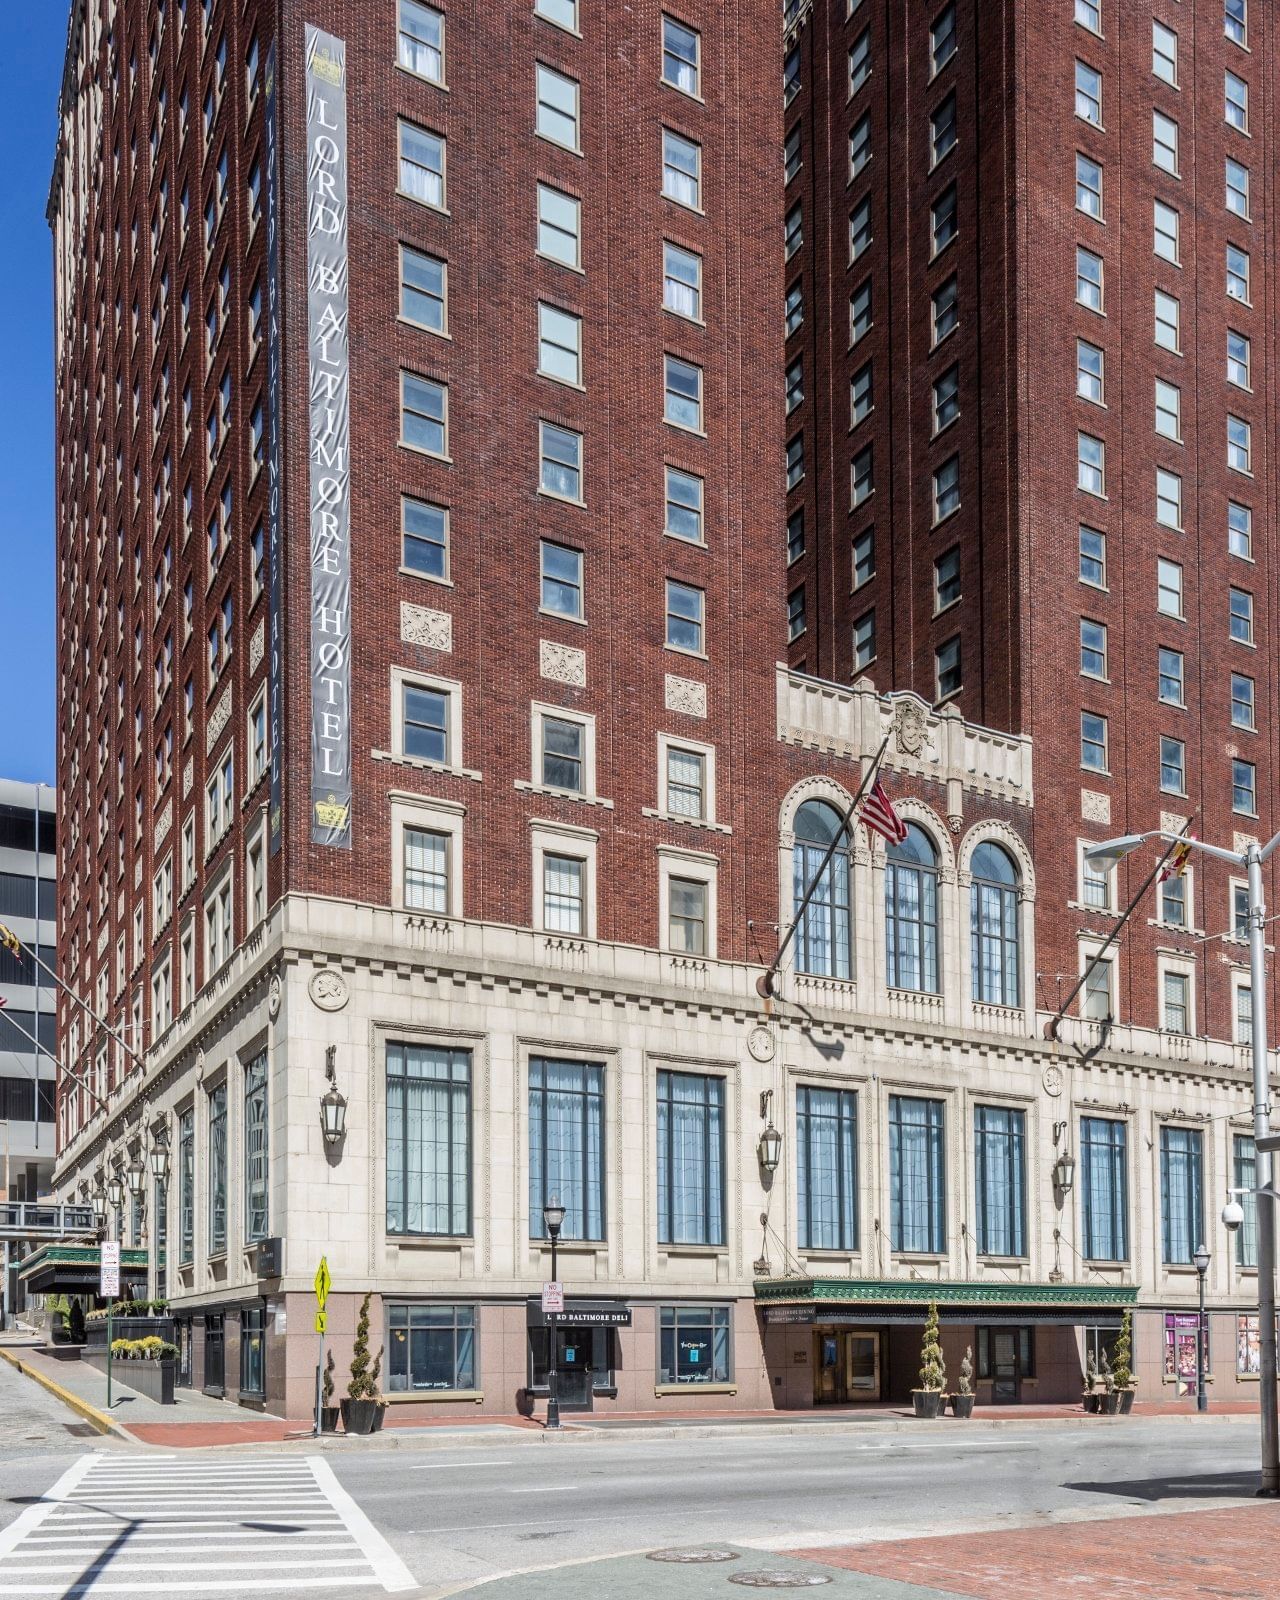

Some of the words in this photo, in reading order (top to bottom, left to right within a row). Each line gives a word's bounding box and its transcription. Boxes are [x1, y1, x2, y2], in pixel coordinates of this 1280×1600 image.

[315, 97, 341, 234] LORD
[315, 263, 346, 576] BALTIMORE
[318, 605, 344, 777] HOTEL
